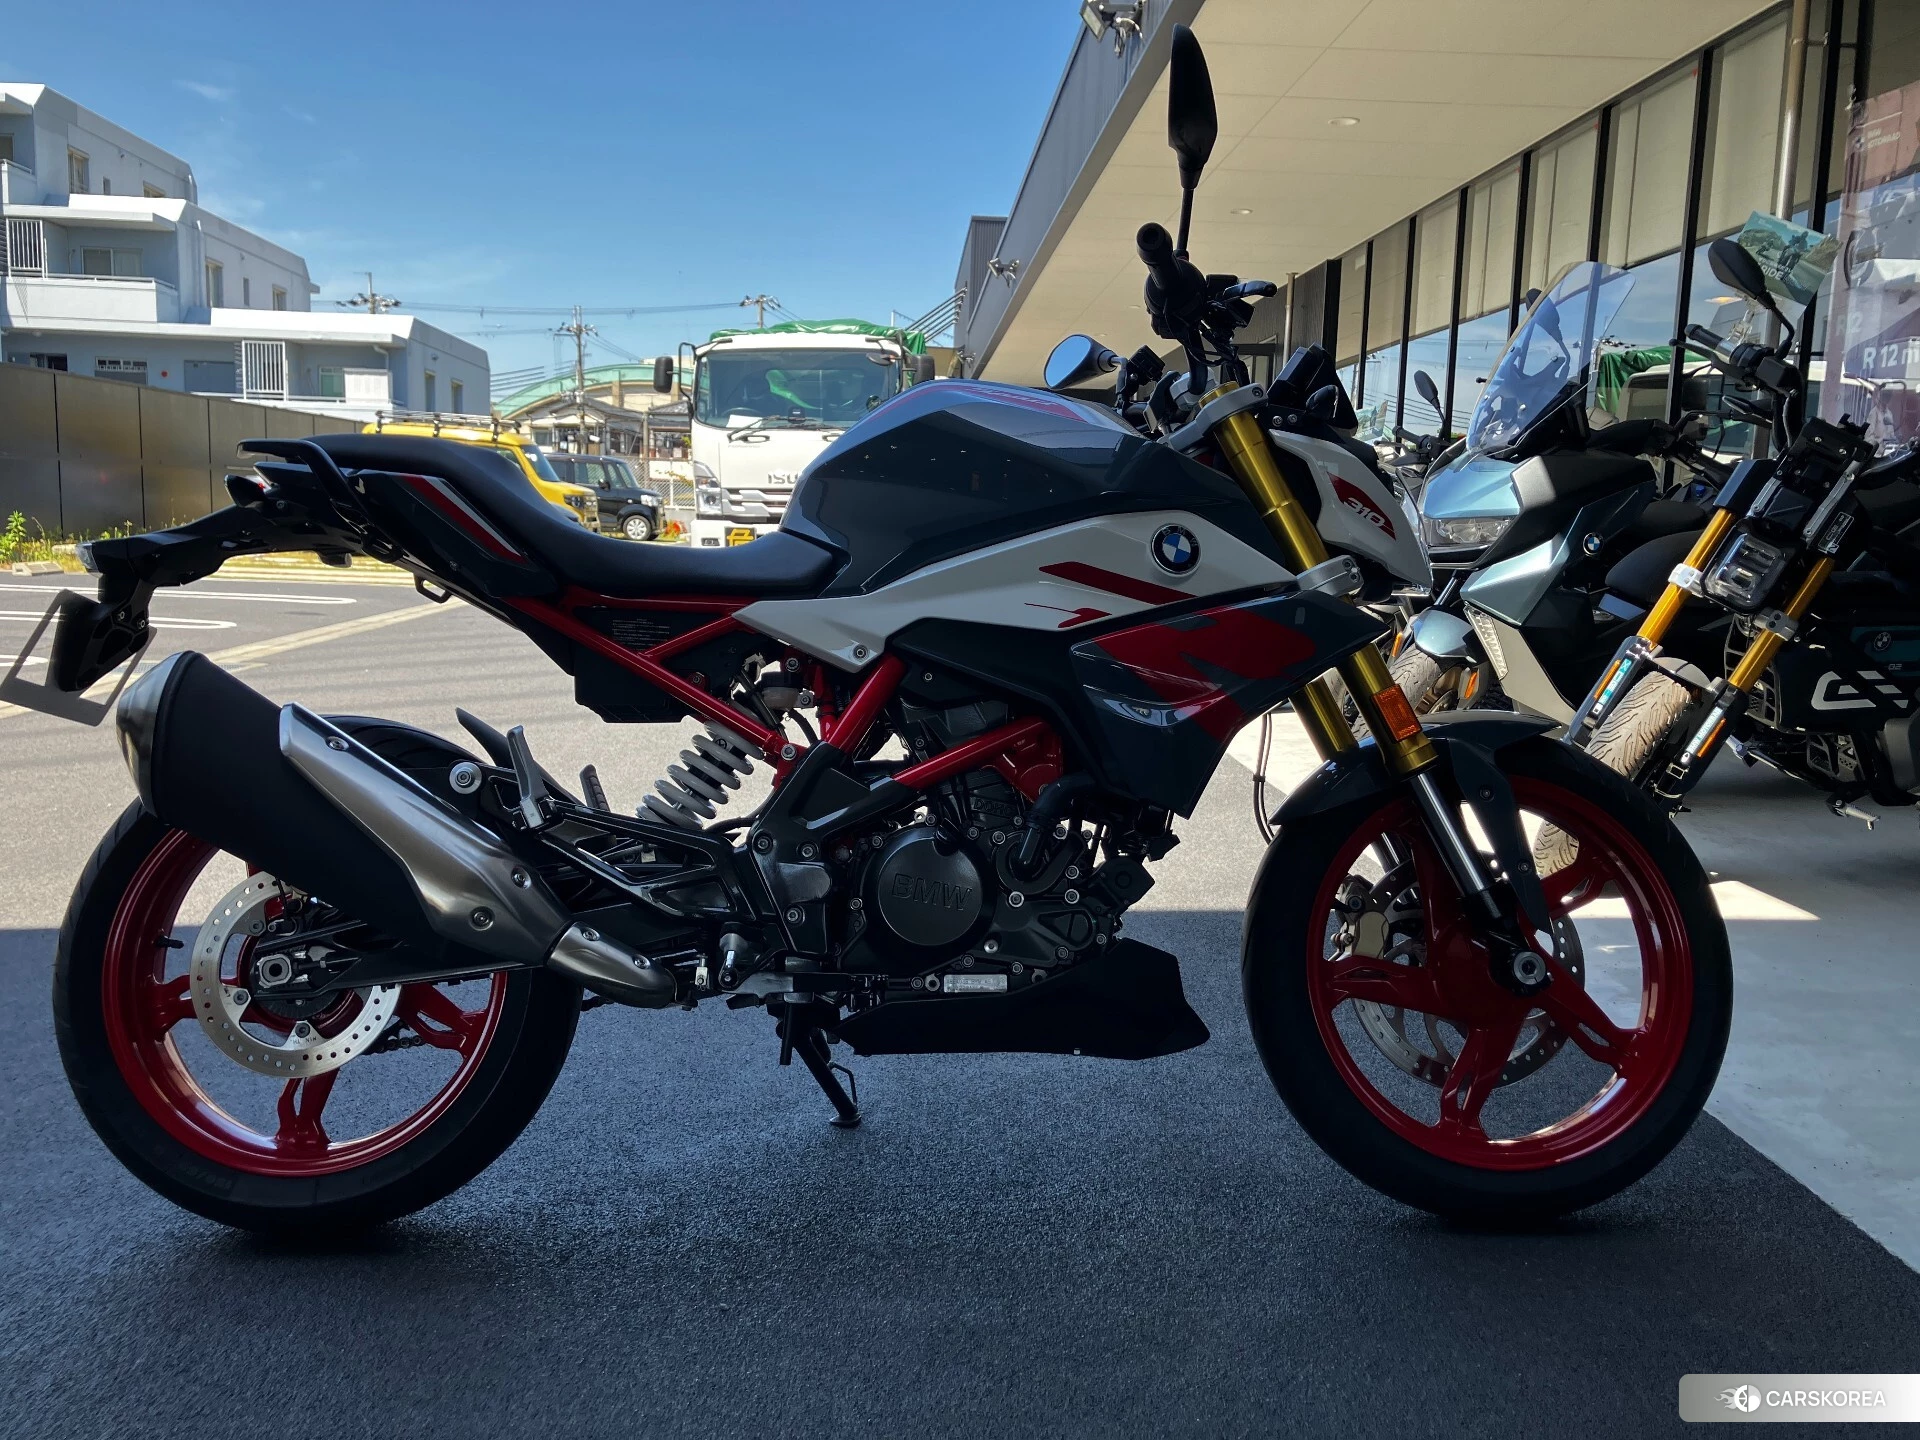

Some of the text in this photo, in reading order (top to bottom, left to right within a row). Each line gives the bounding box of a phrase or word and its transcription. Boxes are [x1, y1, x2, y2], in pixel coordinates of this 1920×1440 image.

[1761, 264, 1784, 281] RIDE
[1863, 347, 1877, 369] R
[1880, 343, 1899, 368] 12
[767, 473, 799, 485] ISU
[1343, 497, 1386, 527] 310
[892, 873, 973, 911] BMW
